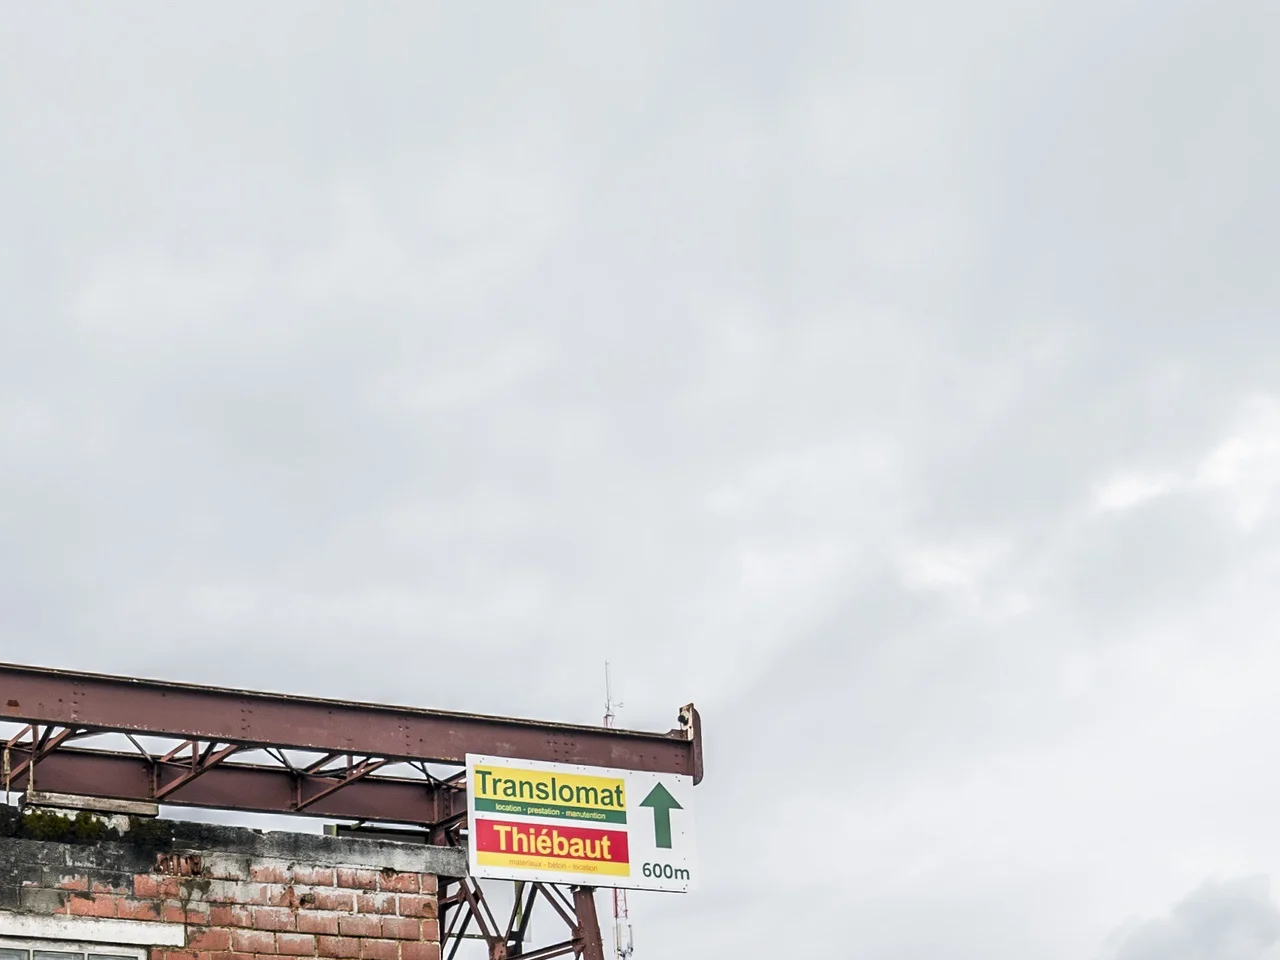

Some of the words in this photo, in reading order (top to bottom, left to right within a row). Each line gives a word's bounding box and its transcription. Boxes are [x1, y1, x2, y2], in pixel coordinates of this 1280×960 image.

[475, 770, 624, 807] Translomat
[495, 803, 522, 812] location
[527, 807, 560, 816] prestation
[493, 824, 612, 860] Thiébaut
[642, 862, 690, 880] 600m
